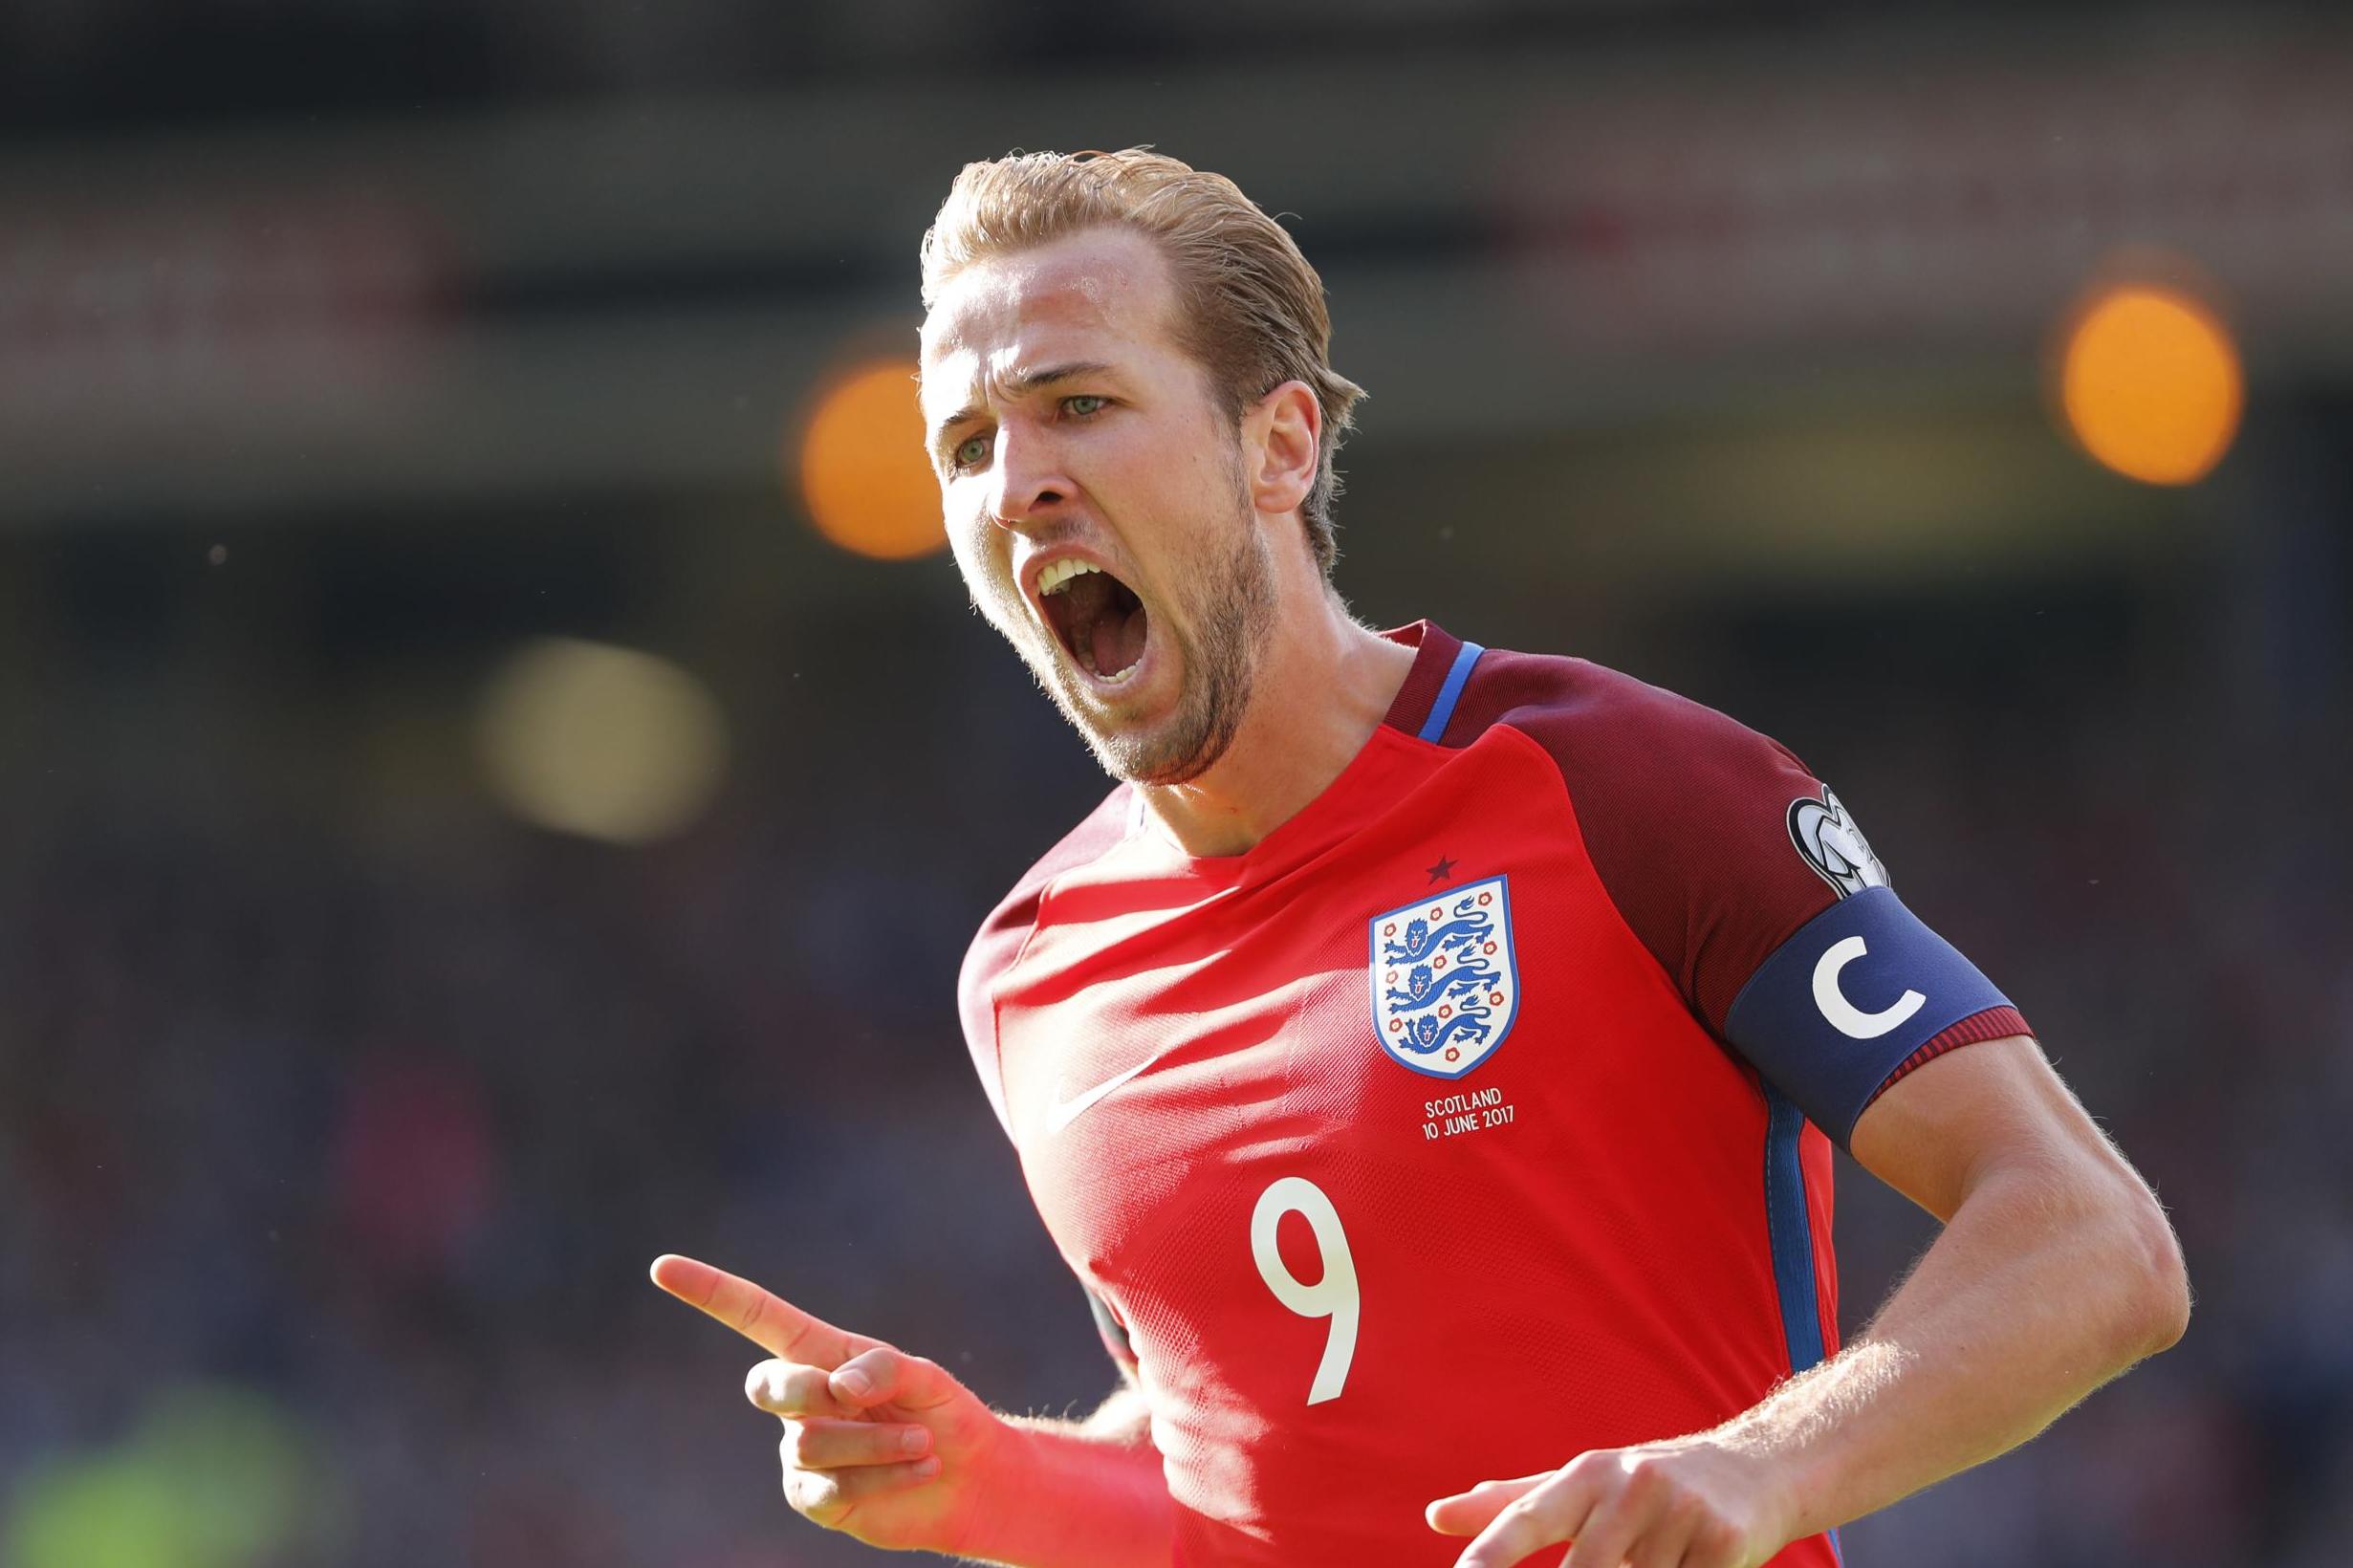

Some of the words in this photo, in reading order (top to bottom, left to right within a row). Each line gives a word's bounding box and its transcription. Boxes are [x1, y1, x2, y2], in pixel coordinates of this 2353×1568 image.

[1812, 935, 1927, 1039] C
[1422, 1122, 1439, 1141] 10
[1444, 1113, 1480, 1136] JUNE
[1482, 1104, 1514, 1128] 2017
[1425, 1087, 1502, 1119] SCOTLAND
[1251, 1176, 1361, 1406] 9
